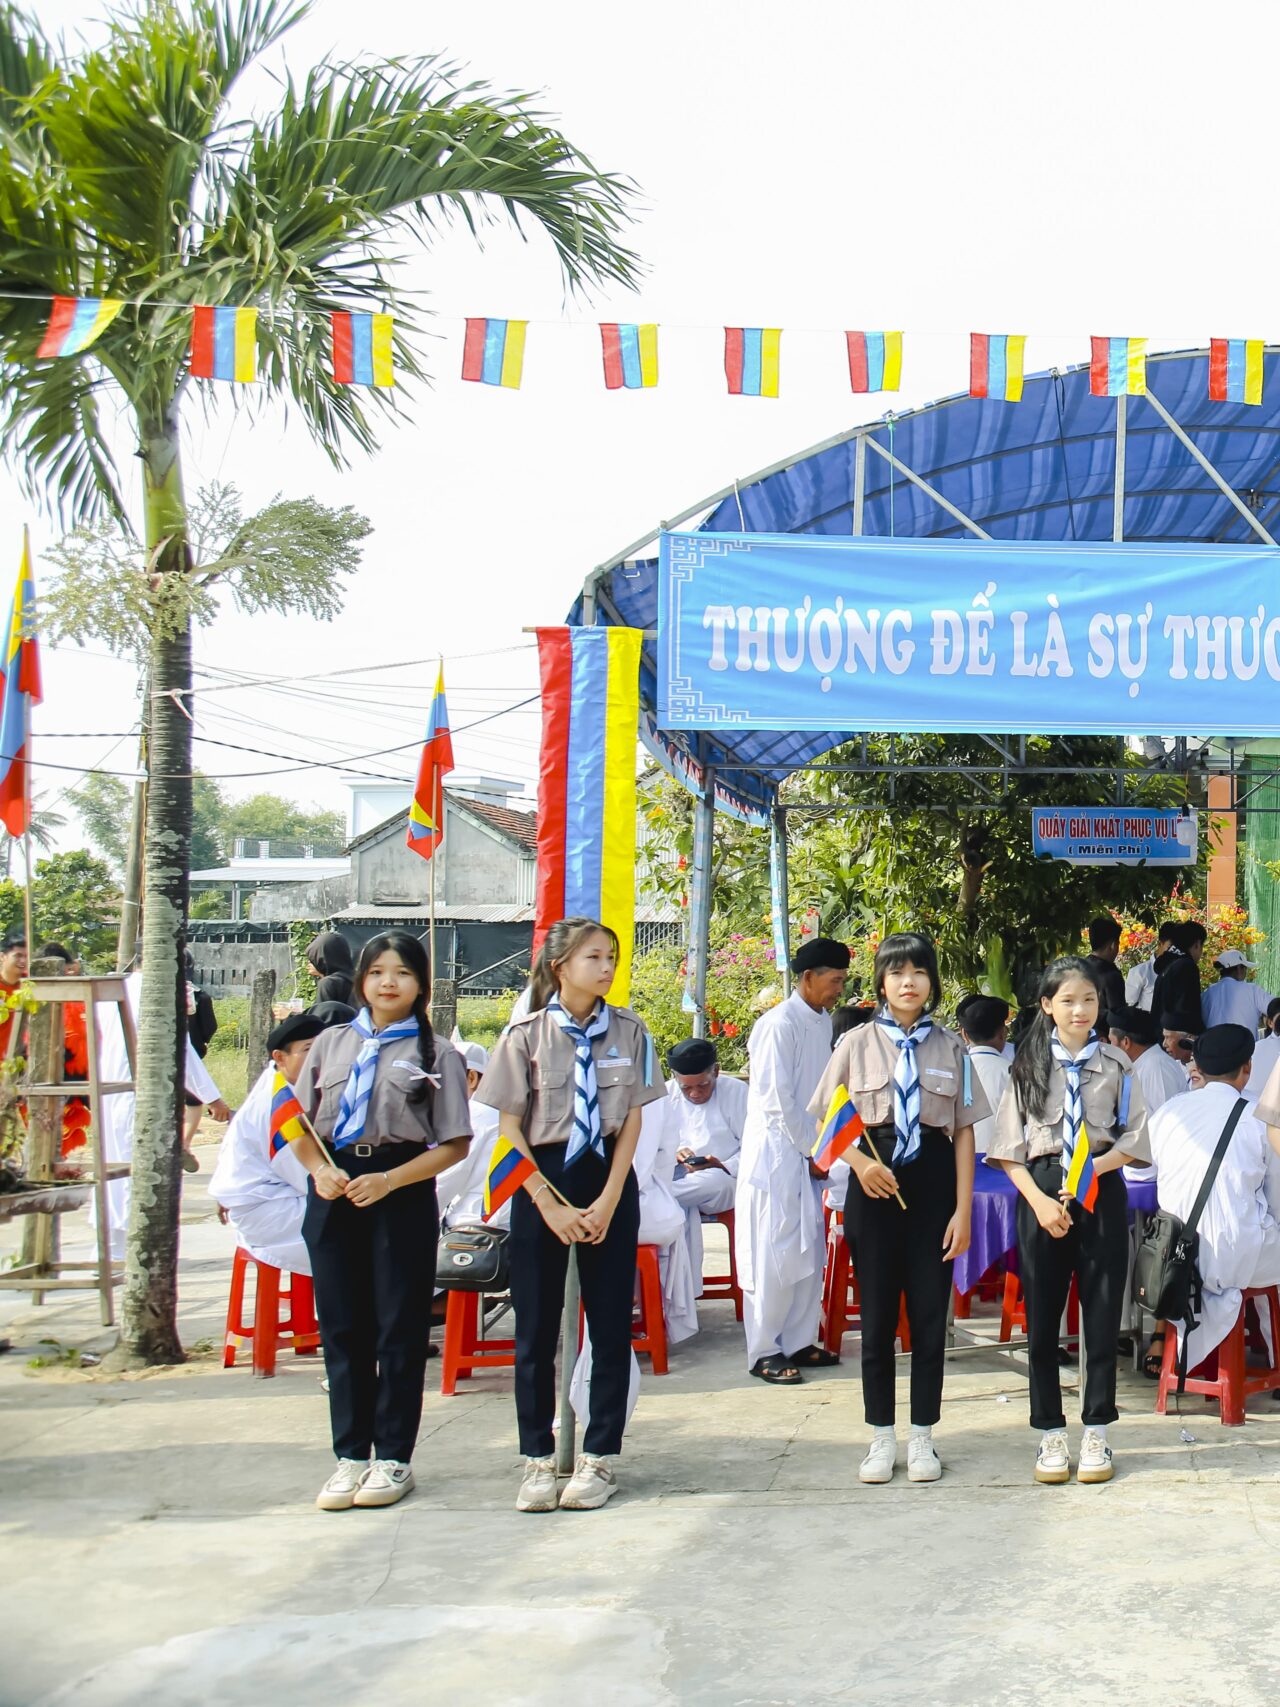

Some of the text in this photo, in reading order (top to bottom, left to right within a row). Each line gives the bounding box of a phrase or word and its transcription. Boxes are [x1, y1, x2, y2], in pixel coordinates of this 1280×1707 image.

[703, 595, 915, 692] THƯỢNG
[929, 581, 997, 677] ĐẾ
[1010, 593, 1073, 678] LÀ
[1087, 602, 1153, 698] SỰ
[1069, 811, 1091, 839] GIẢI
[1093, 813, 1121, 839] KHÁT
[1123, 817, 1152, 843] PHỤC
[1154, 817, 1169, 843] VỤ
